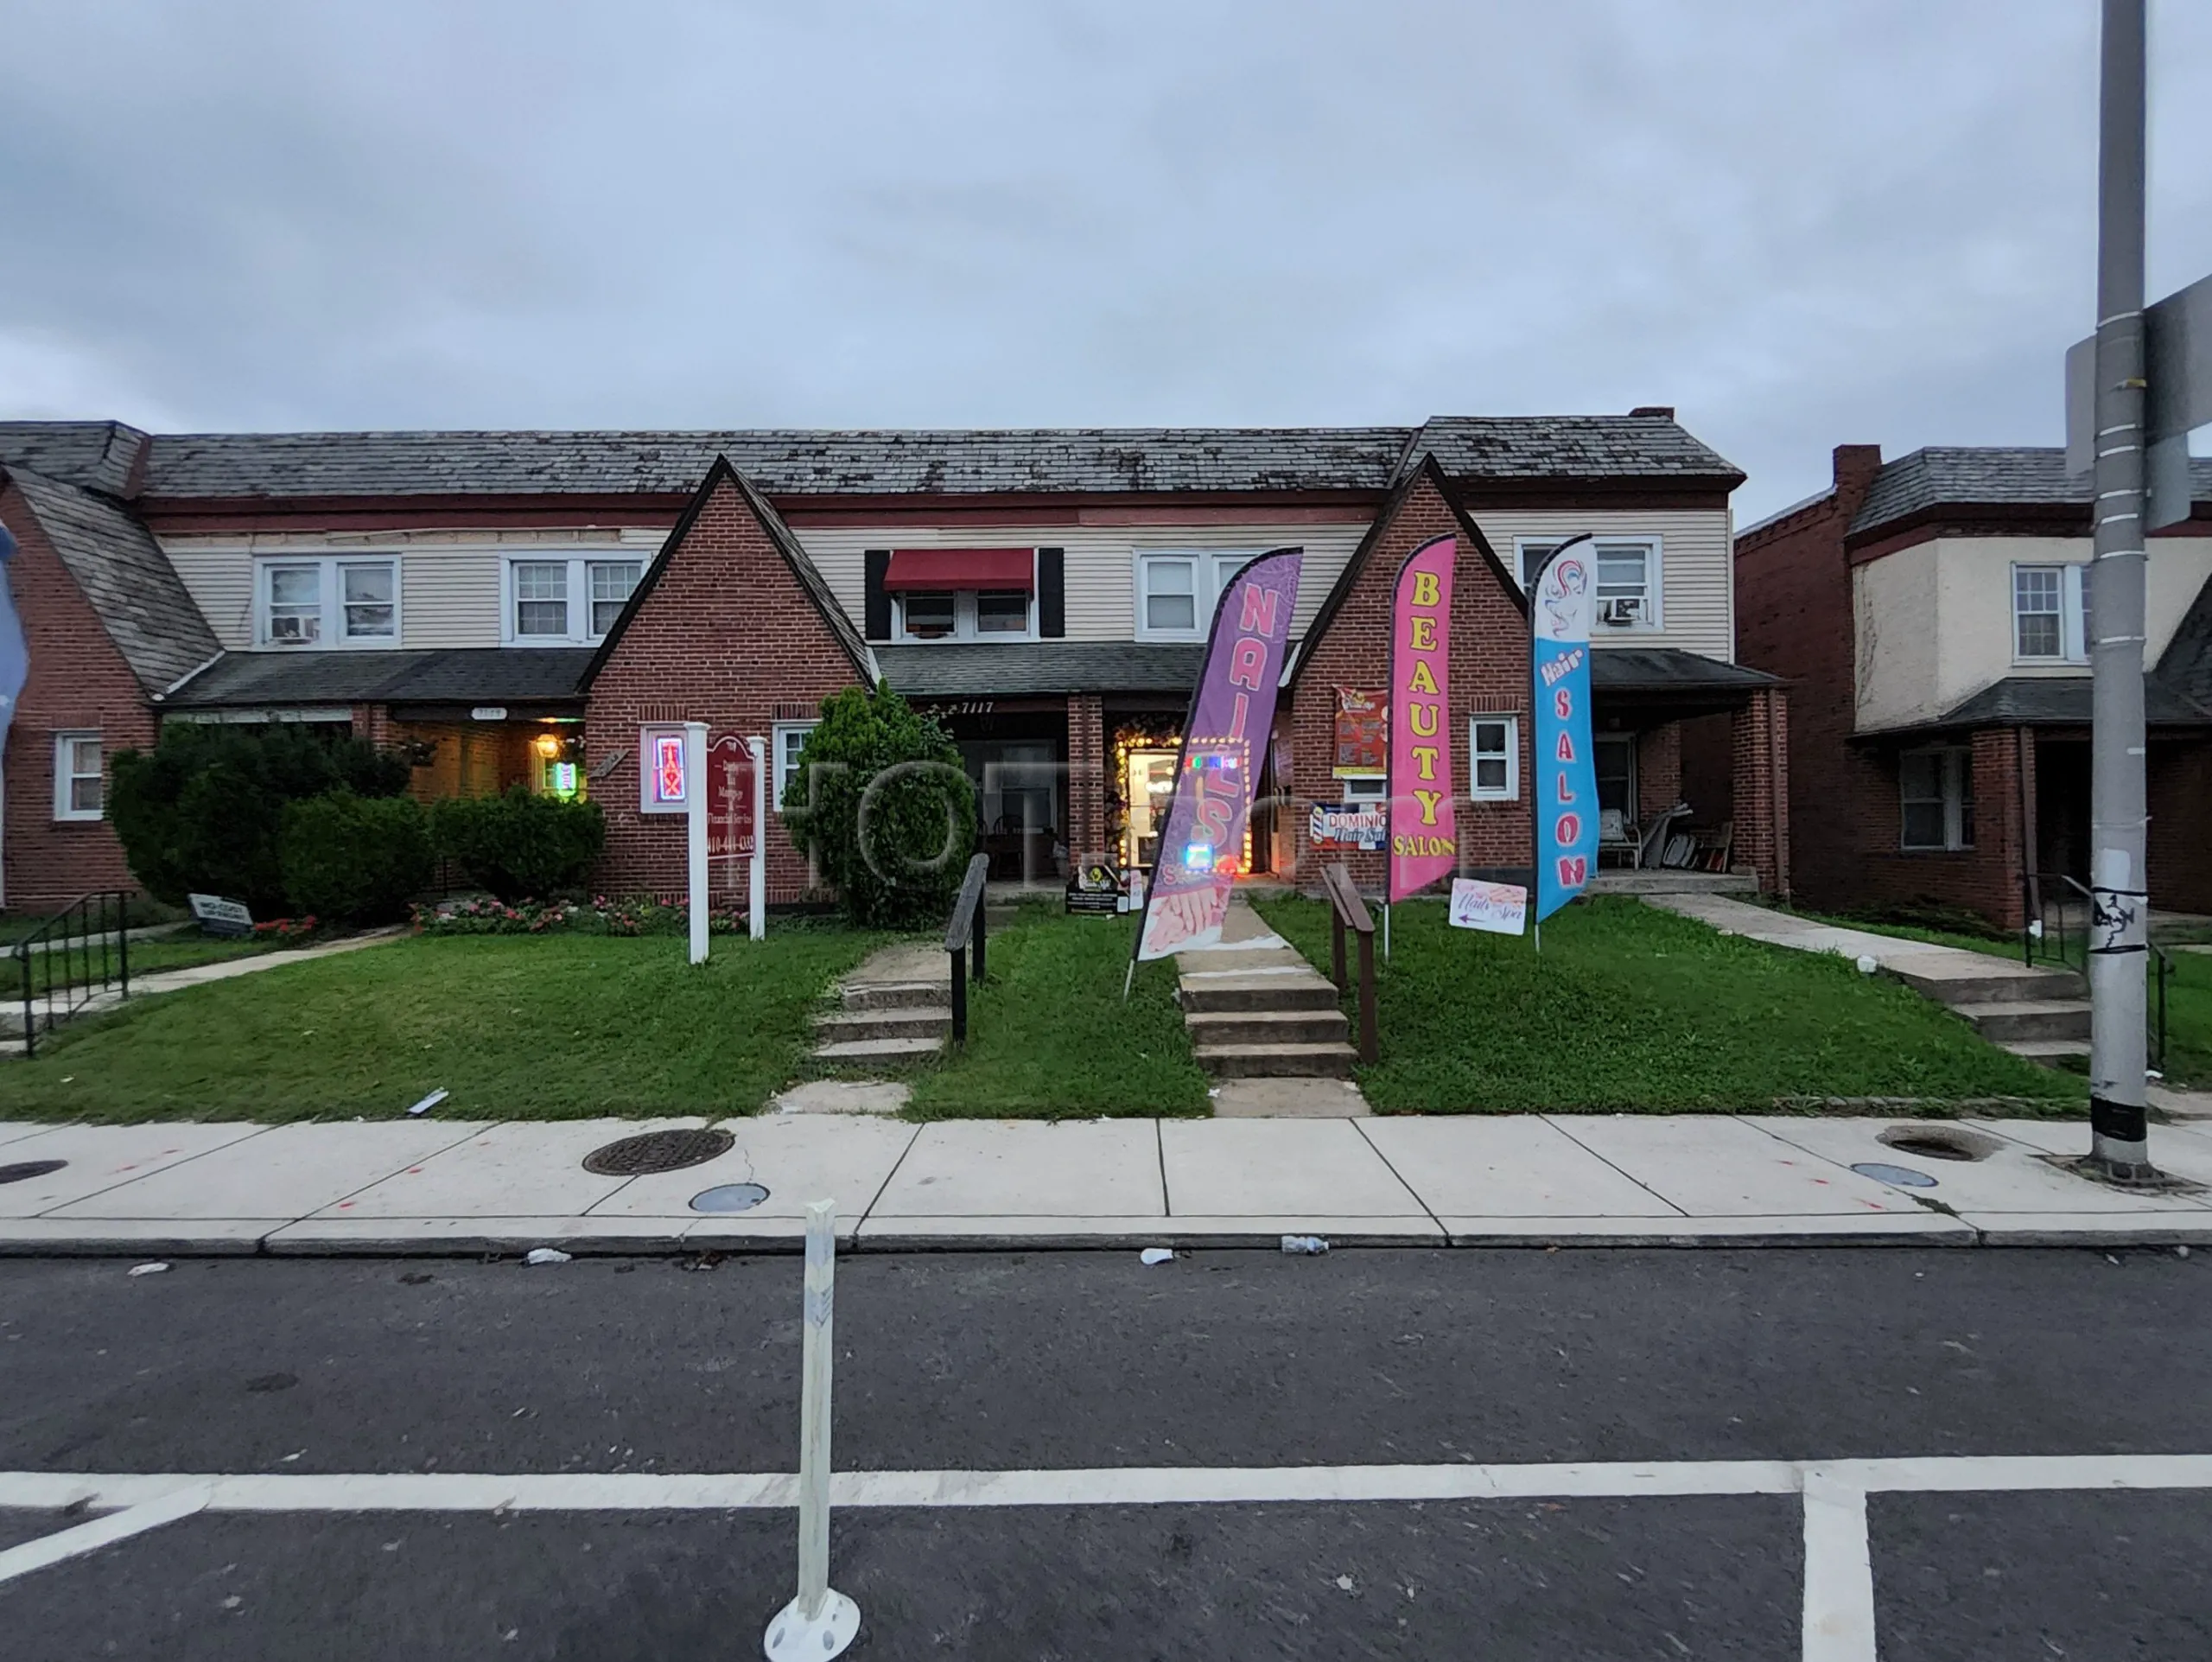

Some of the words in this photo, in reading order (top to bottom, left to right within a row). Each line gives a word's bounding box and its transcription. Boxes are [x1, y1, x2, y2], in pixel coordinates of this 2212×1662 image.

[1540, 648, 1585, 689] Hair
[961, 701, 995, 715] 7117
[1191, 582, 1278, 849] NAILS
[1408, 570, 1441, 827] BEAUTY
[662, 742, 681, 797] TAX
[1554, 685, 1589, 888] SALON
[1334, 828, 1363, 842] Hair
[1392, 834, 1455, 857] SALON
